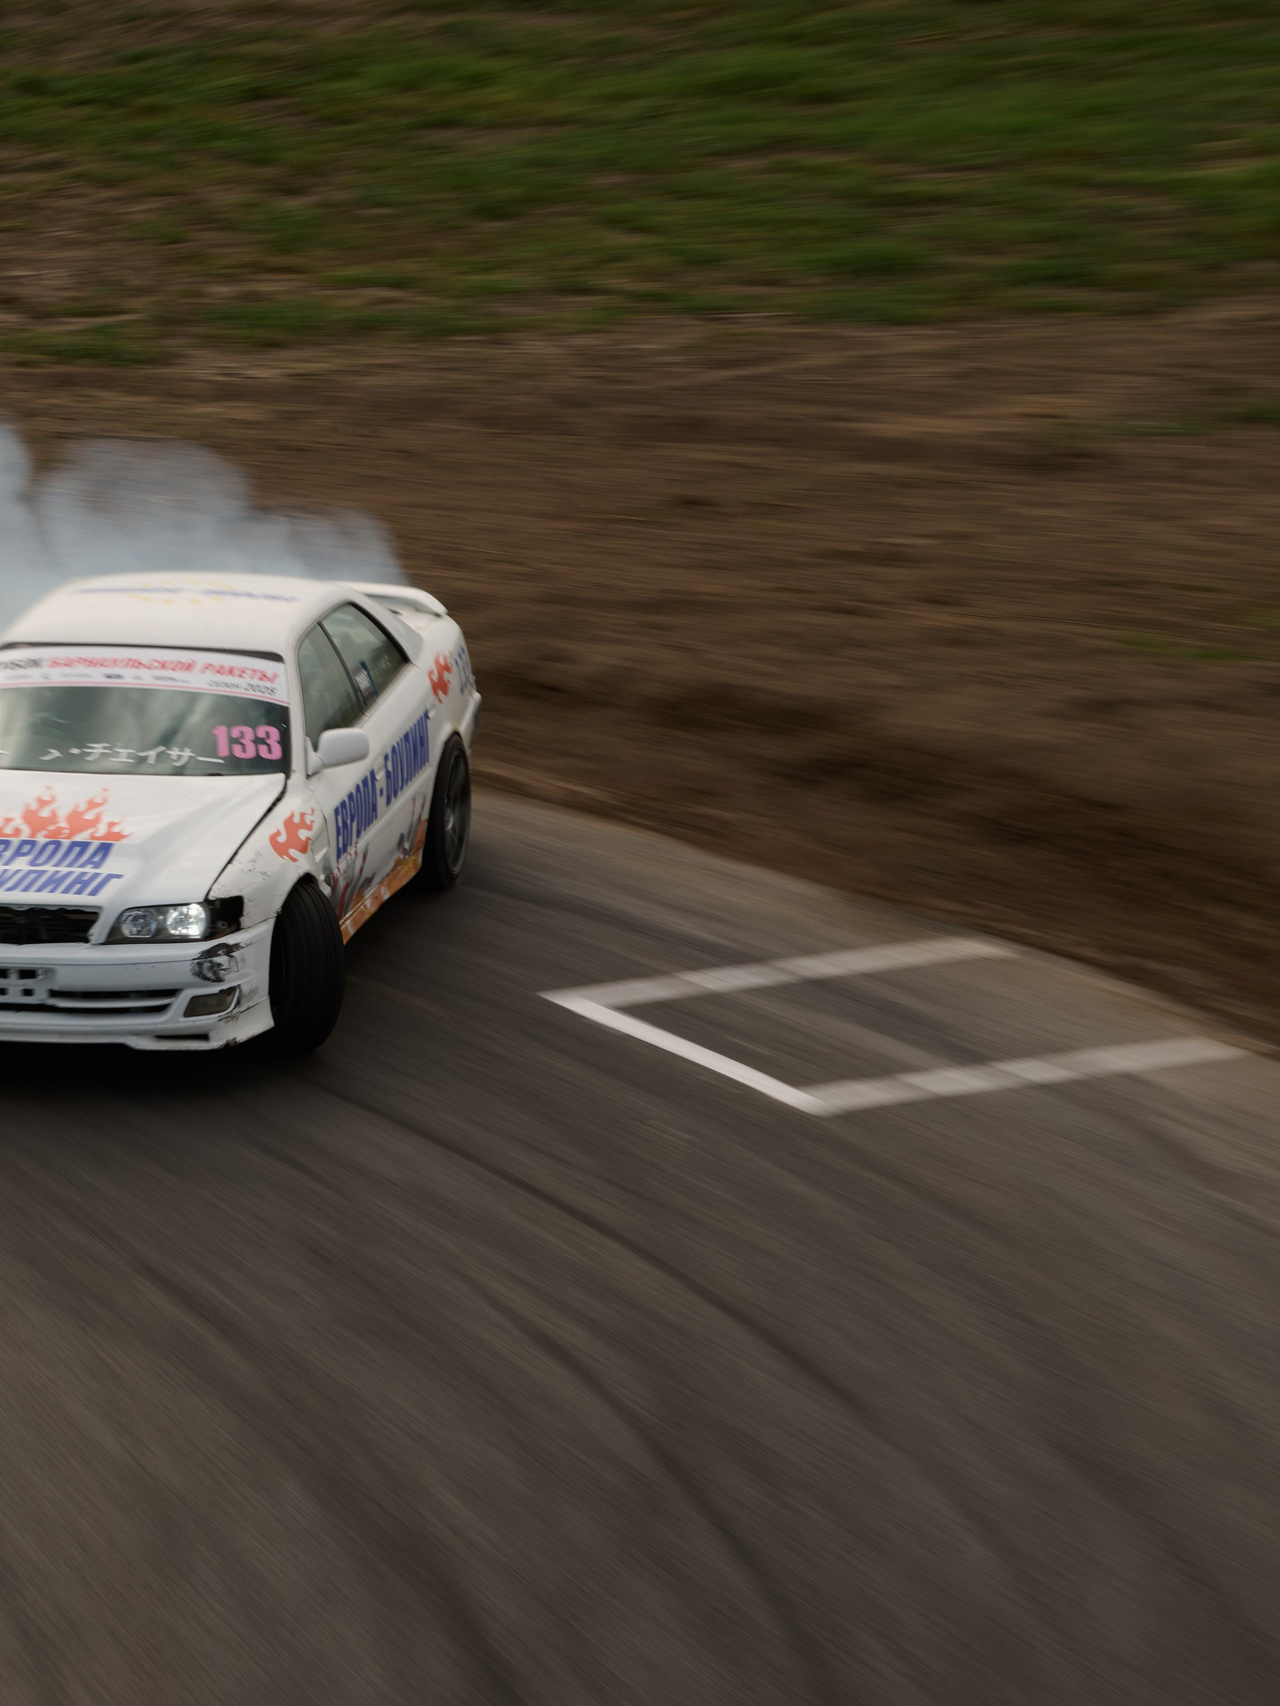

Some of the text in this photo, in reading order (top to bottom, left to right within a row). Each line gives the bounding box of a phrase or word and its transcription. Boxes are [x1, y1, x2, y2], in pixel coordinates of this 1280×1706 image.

[200, 662, 279, 684] РАКЕТЫ
[212, 725, 283, 760] 133
[334, 769, 378, 865] ЕВРОПА
[384, 709, 430, 808] БОУЛИНГ
